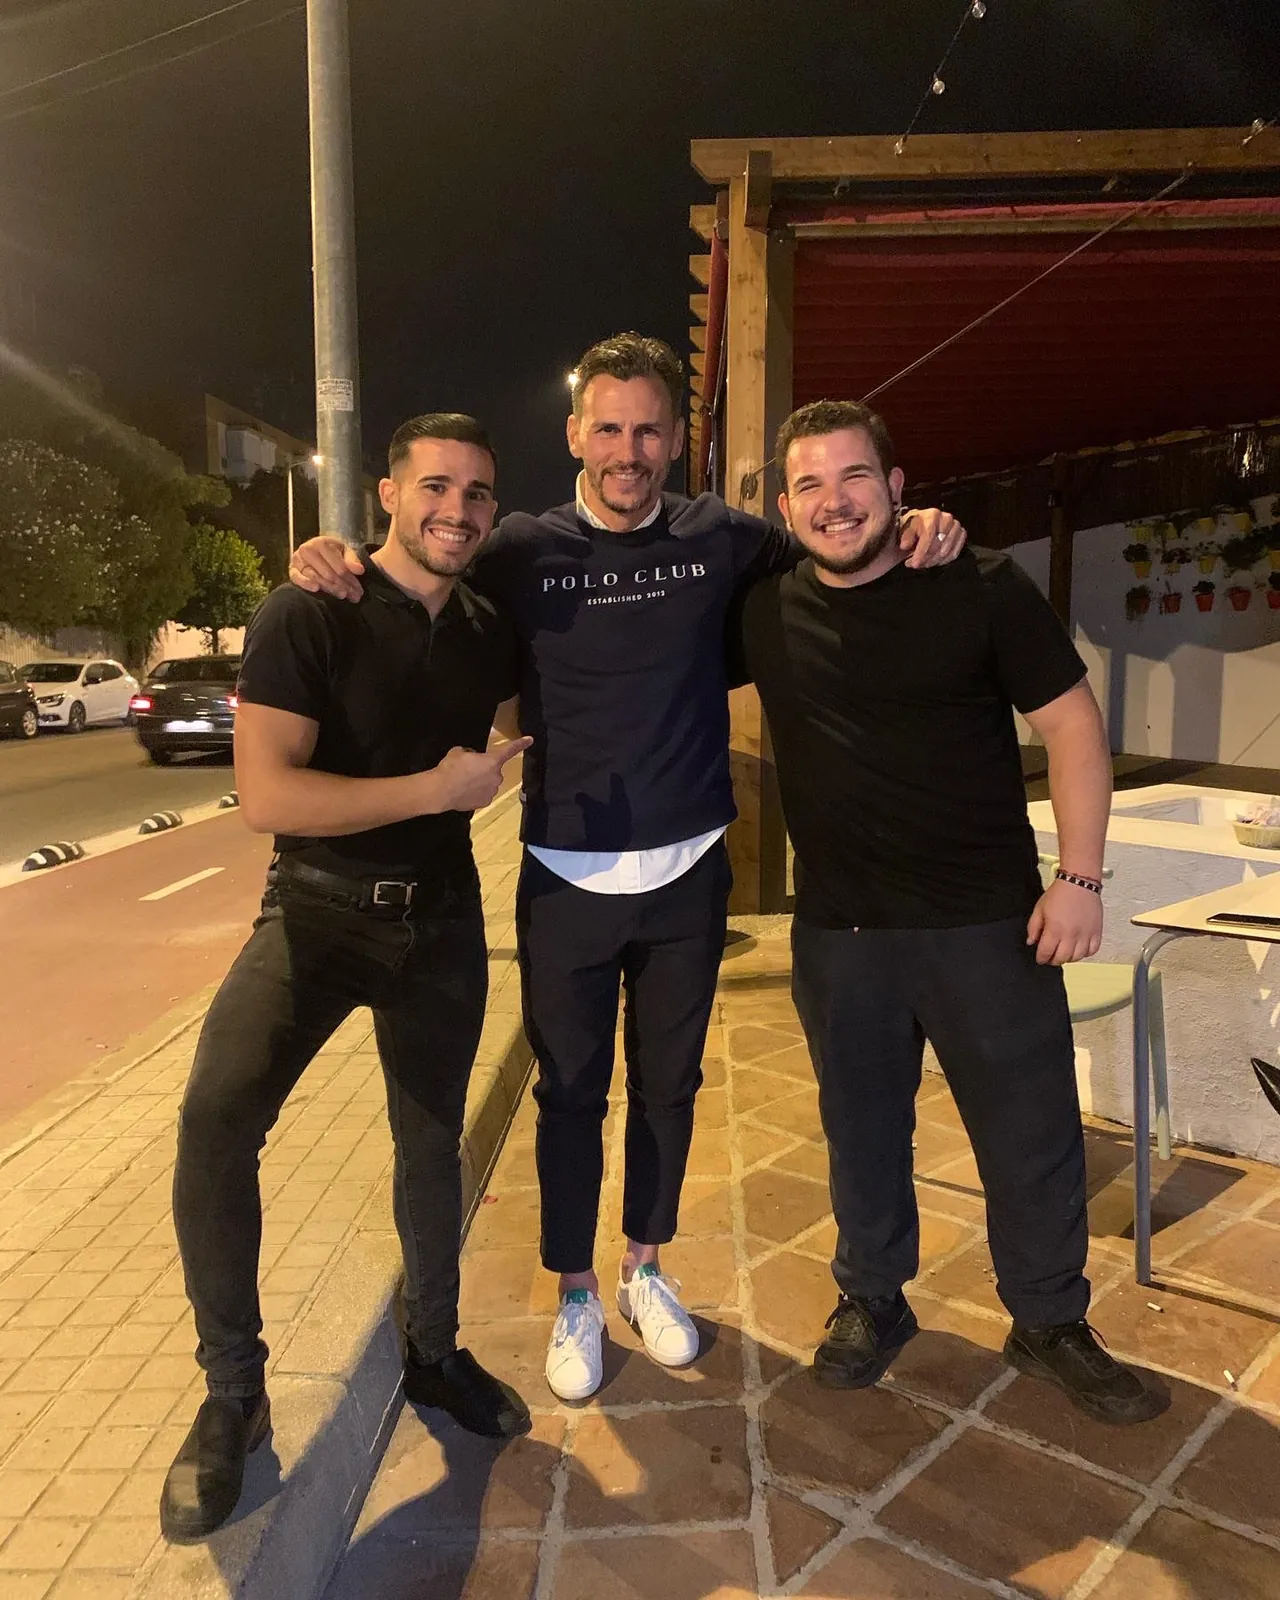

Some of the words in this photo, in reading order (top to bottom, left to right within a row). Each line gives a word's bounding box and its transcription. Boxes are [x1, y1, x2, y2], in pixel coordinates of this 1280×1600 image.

[542, 572, 618, 592] POLO
[634, 563, 706, 584] CLUB
[587, 594, 642, 606] ESTABLISHED
[646, 589, 666, 599] 2012
